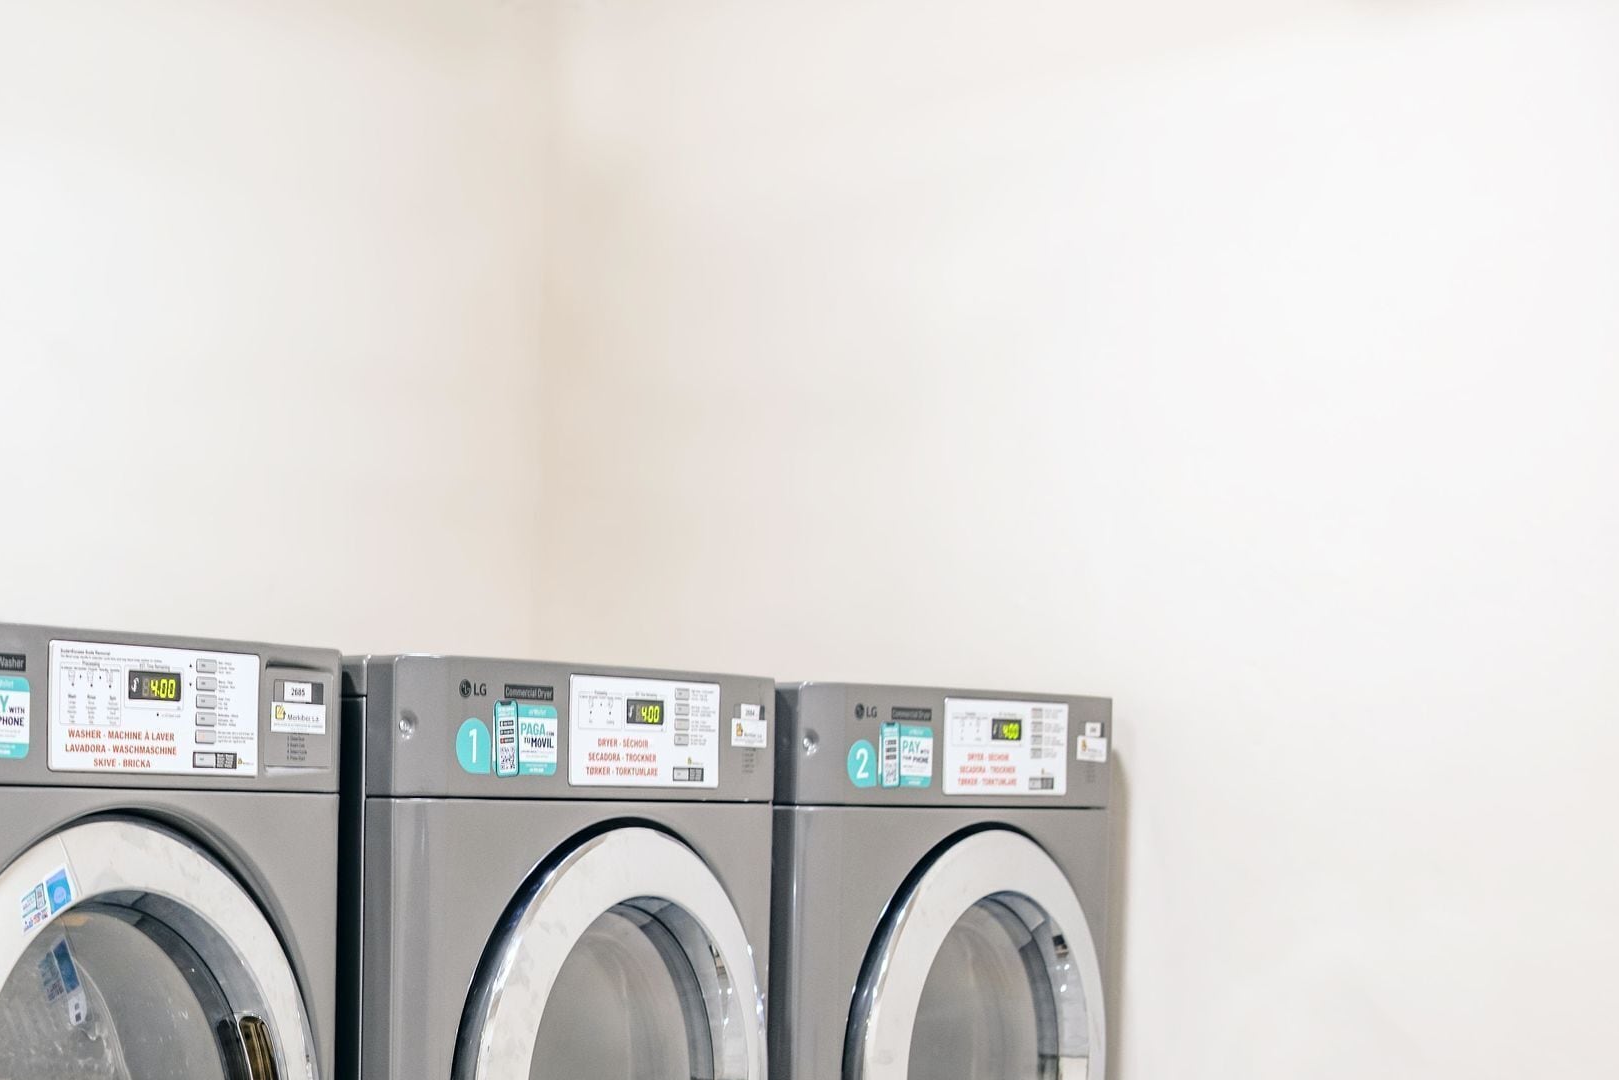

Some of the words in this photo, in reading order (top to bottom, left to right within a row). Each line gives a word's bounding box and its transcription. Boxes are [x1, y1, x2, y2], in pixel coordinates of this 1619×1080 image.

[473, 683, 487, 696] LG
[505, 686, 537, 698] Commercial
[9, 706, 25, 714] WITH
[866, 706, 877, 718] LG
[68, 729, 102, 739] WASHER
[108, 730, 142, 740] MACHINE
[151, 732, 175, 741] LAVER
[521, 722, 545, 736] PAGA
[469, 728, 477, 763] 1
[598, 738, 618, 747] DRYER
[902, 740, 921, 753] PAY
[65, 744, 106, 753] LAVADORA
[112, 745, 177, 755] WASCHMASCHINE
[93, 758, 116, 767] SKIVE
[123, 759, 151, 768] BRICKA
[588, 752, 620, 761] SECADORA
[625, 753, 657, 762] TROCKNER
[856, 748, 869, 779] 2
[616, 767, 658, 776] TORKTUMLARE
